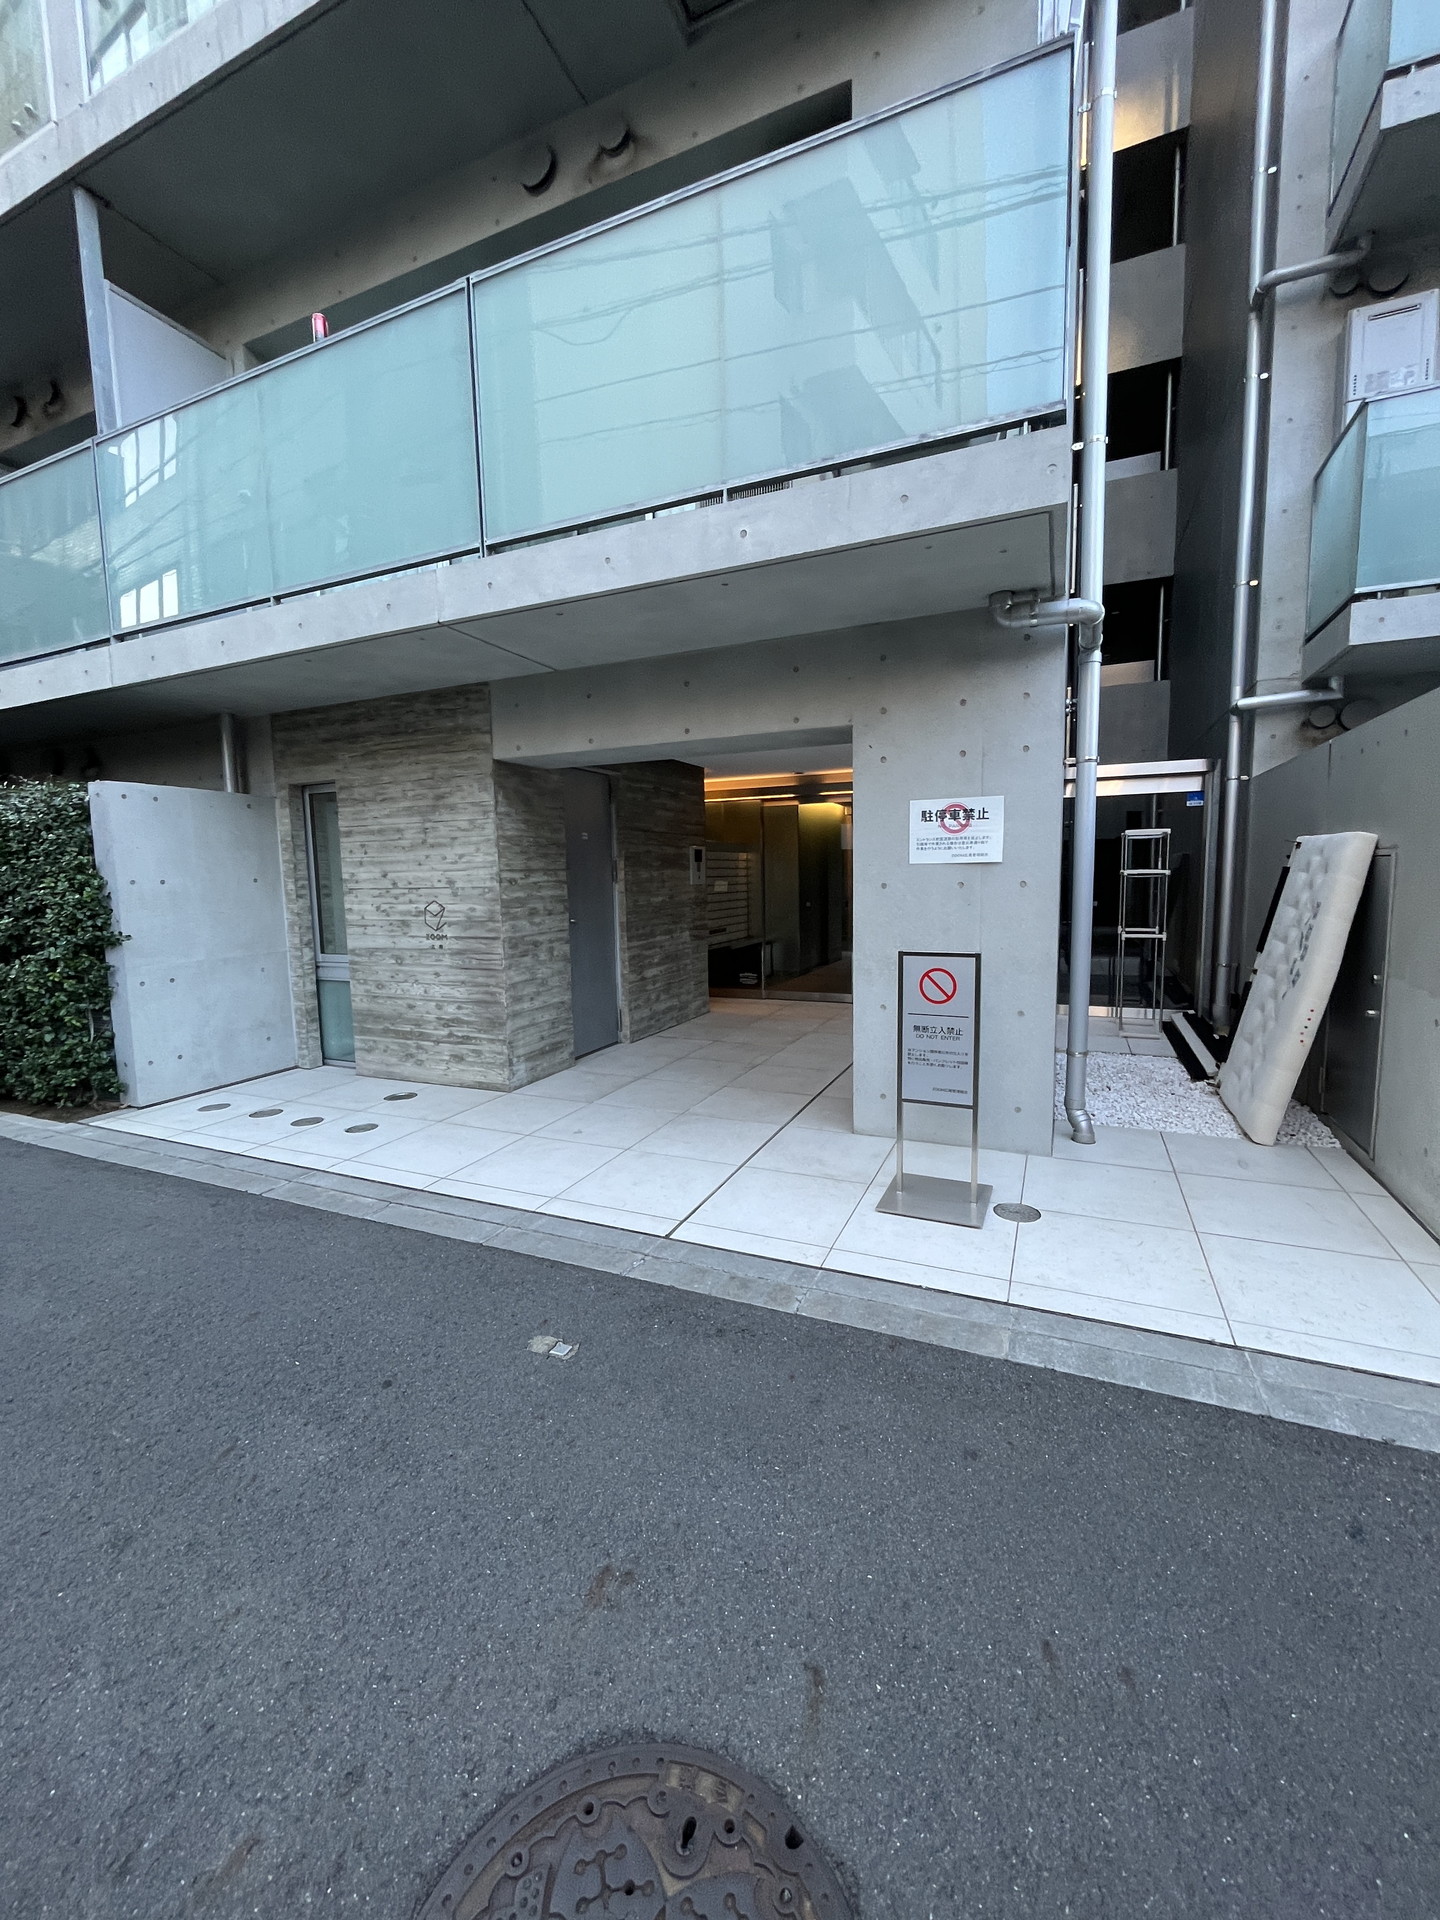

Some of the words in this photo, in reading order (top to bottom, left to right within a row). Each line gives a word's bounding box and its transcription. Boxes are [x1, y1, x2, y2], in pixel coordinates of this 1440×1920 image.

[921, 807, 989, 823] 駐停車禁止
[913, 1025, 963, 1036] 無断立入禁止
